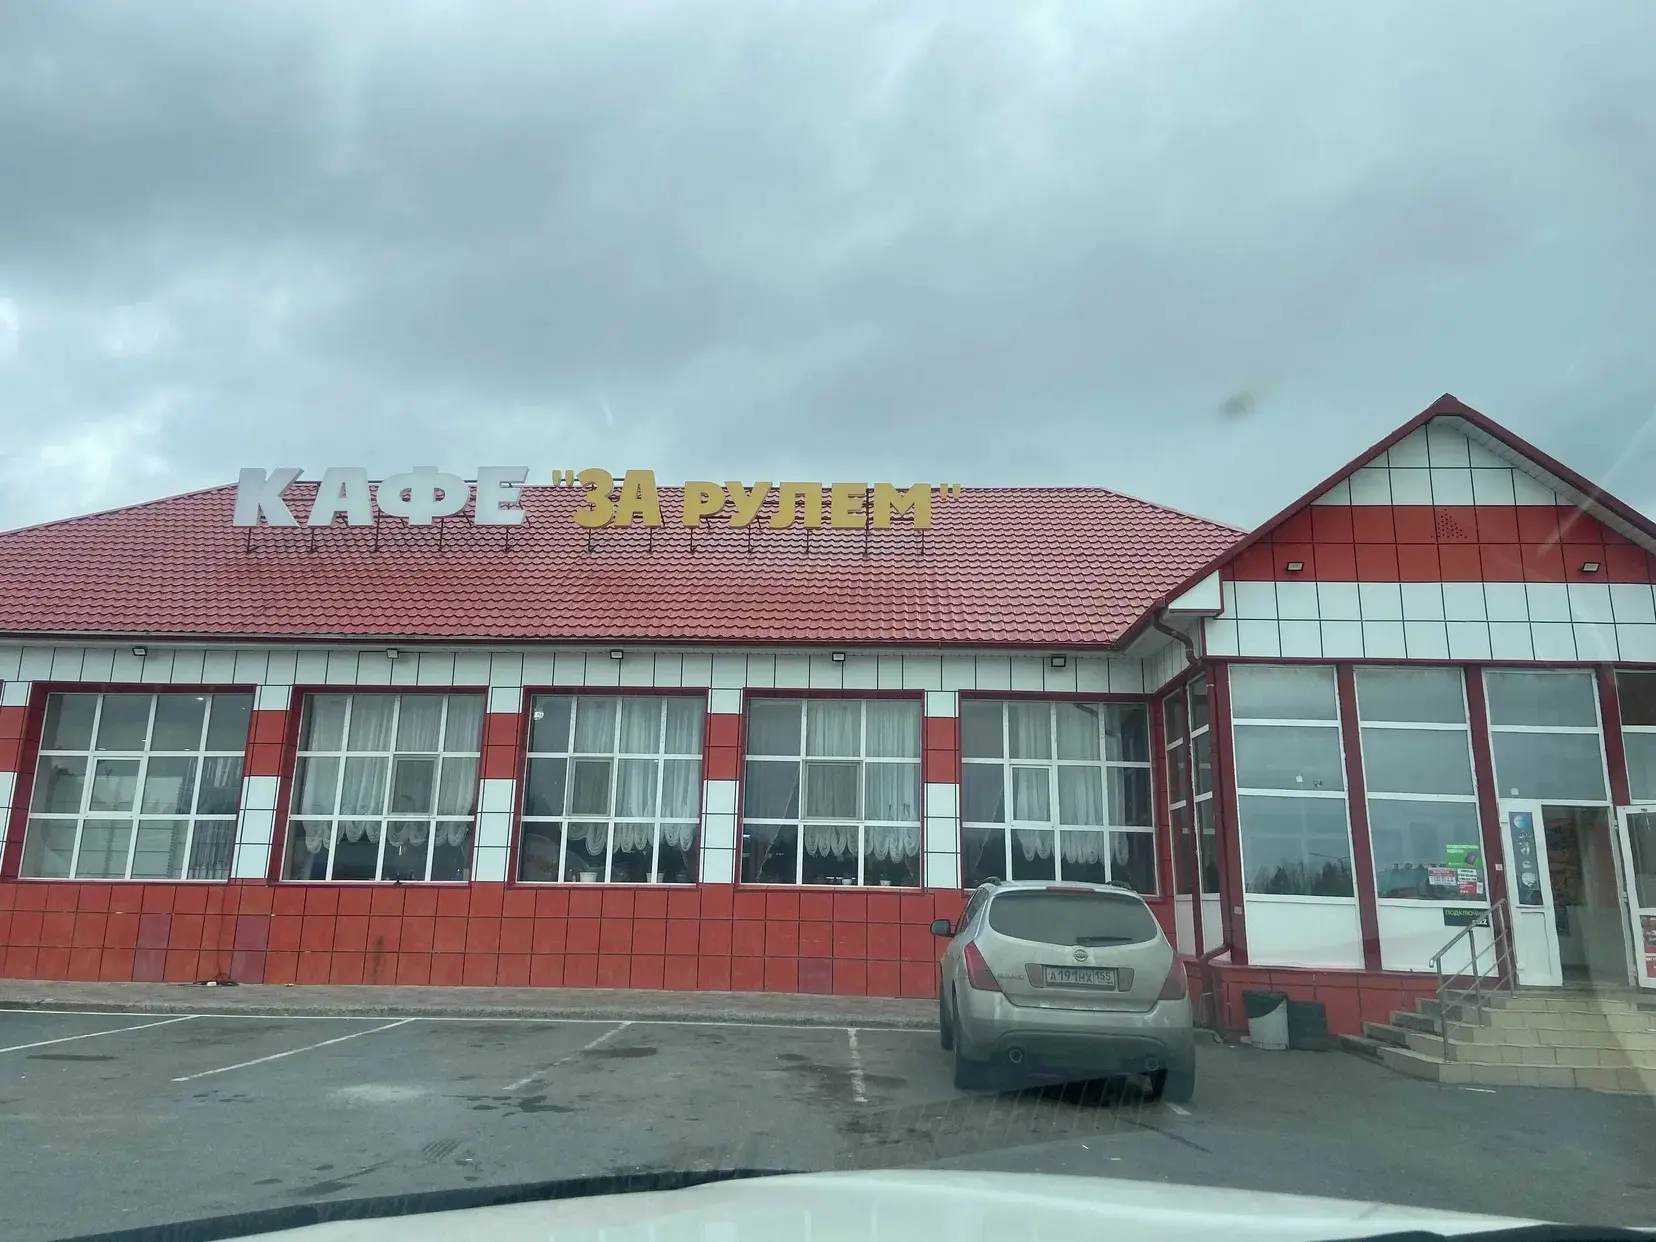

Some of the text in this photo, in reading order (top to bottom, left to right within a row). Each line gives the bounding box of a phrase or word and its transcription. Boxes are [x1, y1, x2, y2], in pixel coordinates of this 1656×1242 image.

[233, 466, 961, 530] КАФЕ "ЗА РУЛЕМ"
